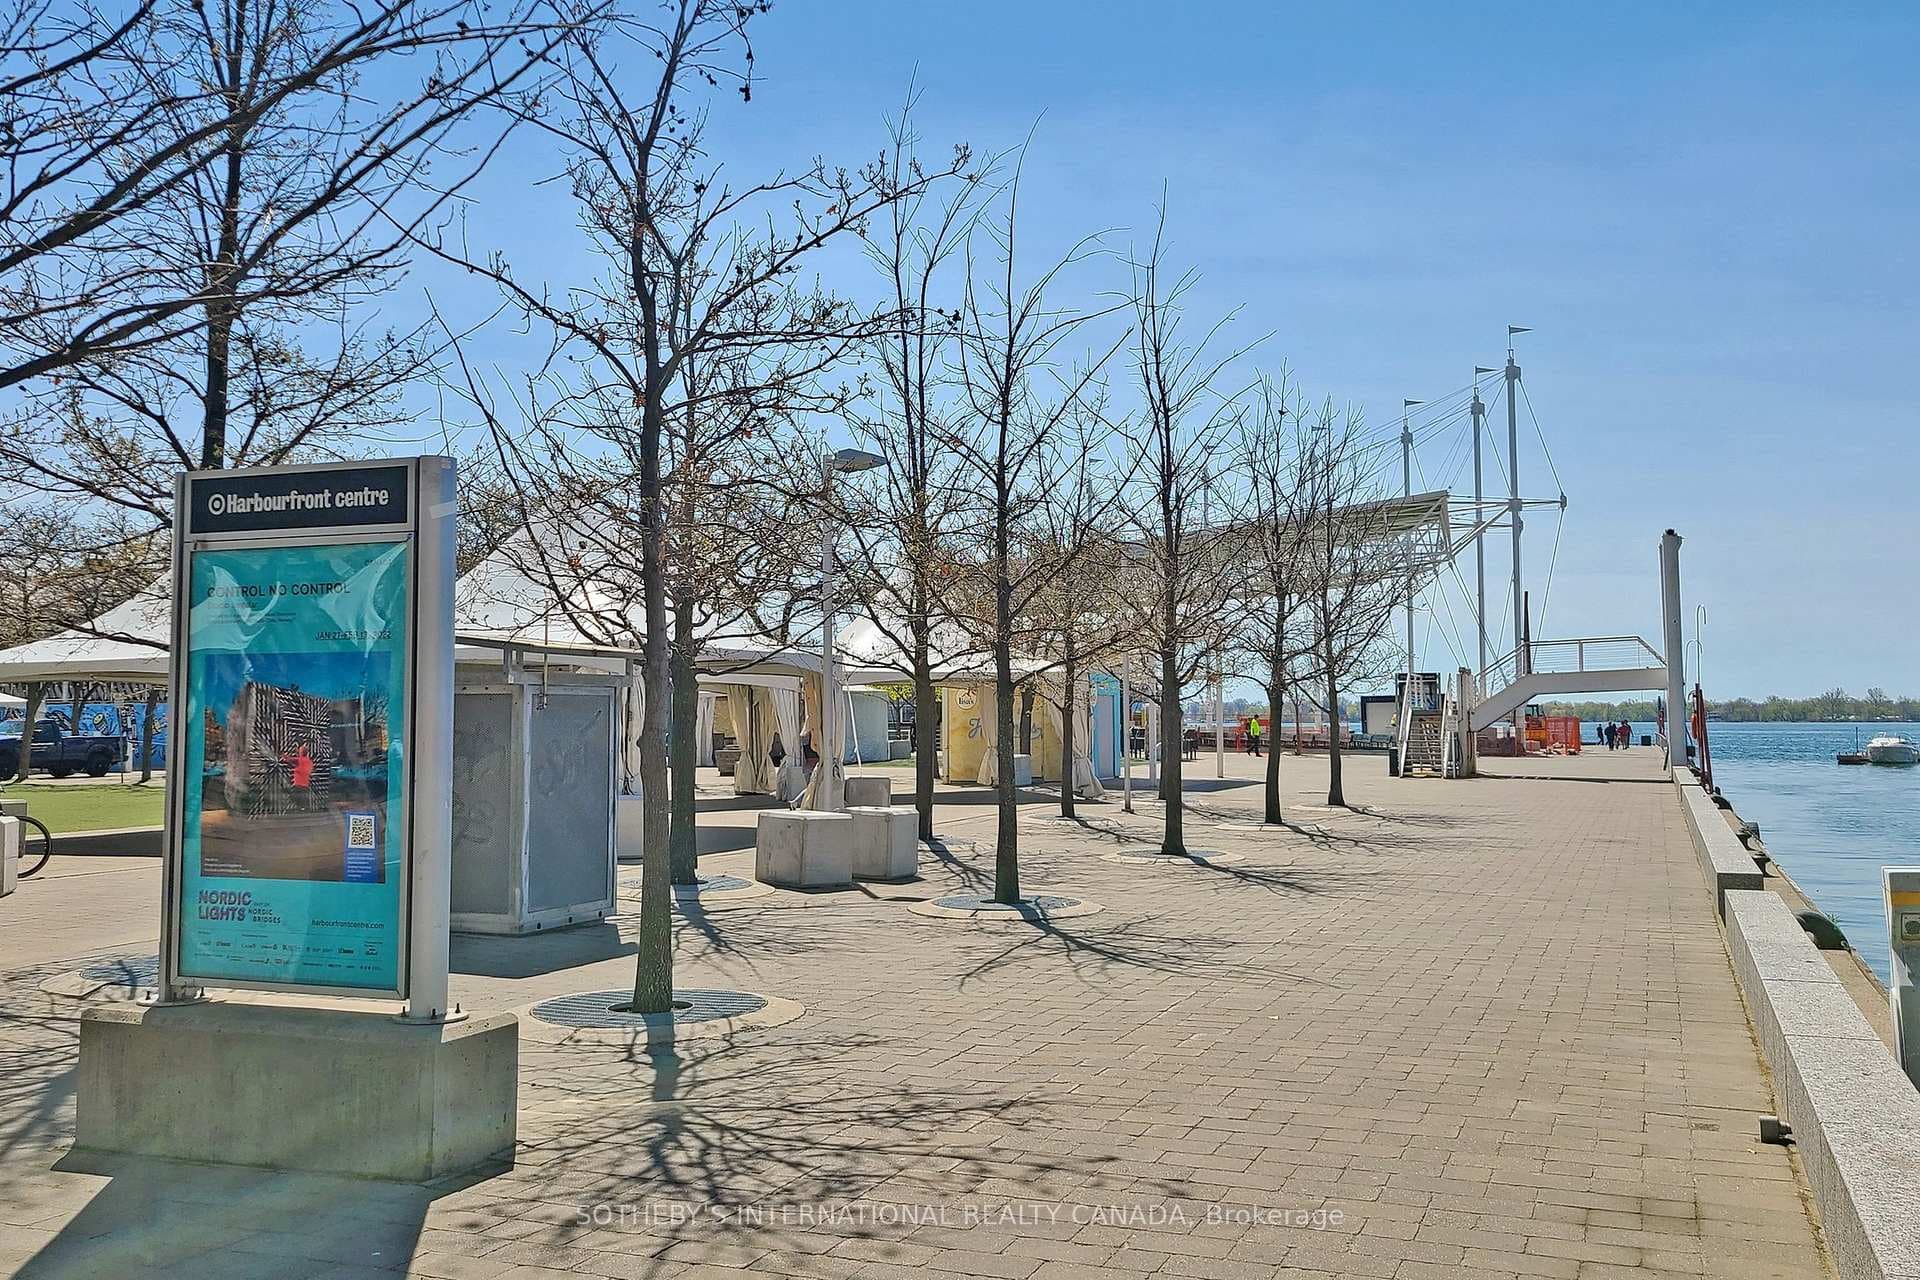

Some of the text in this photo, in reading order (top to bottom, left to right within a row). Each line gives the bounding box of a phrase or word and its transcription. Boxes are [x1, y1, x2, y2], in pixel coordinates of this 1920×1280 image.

[227, 487, 389, 513] Harbourfront centre
[207, 582, 350, 598] CONTROL NO CONTROL
[198, 889, 252, 906] NORDIC
[198, 906, 246, 922] LIGHTS
